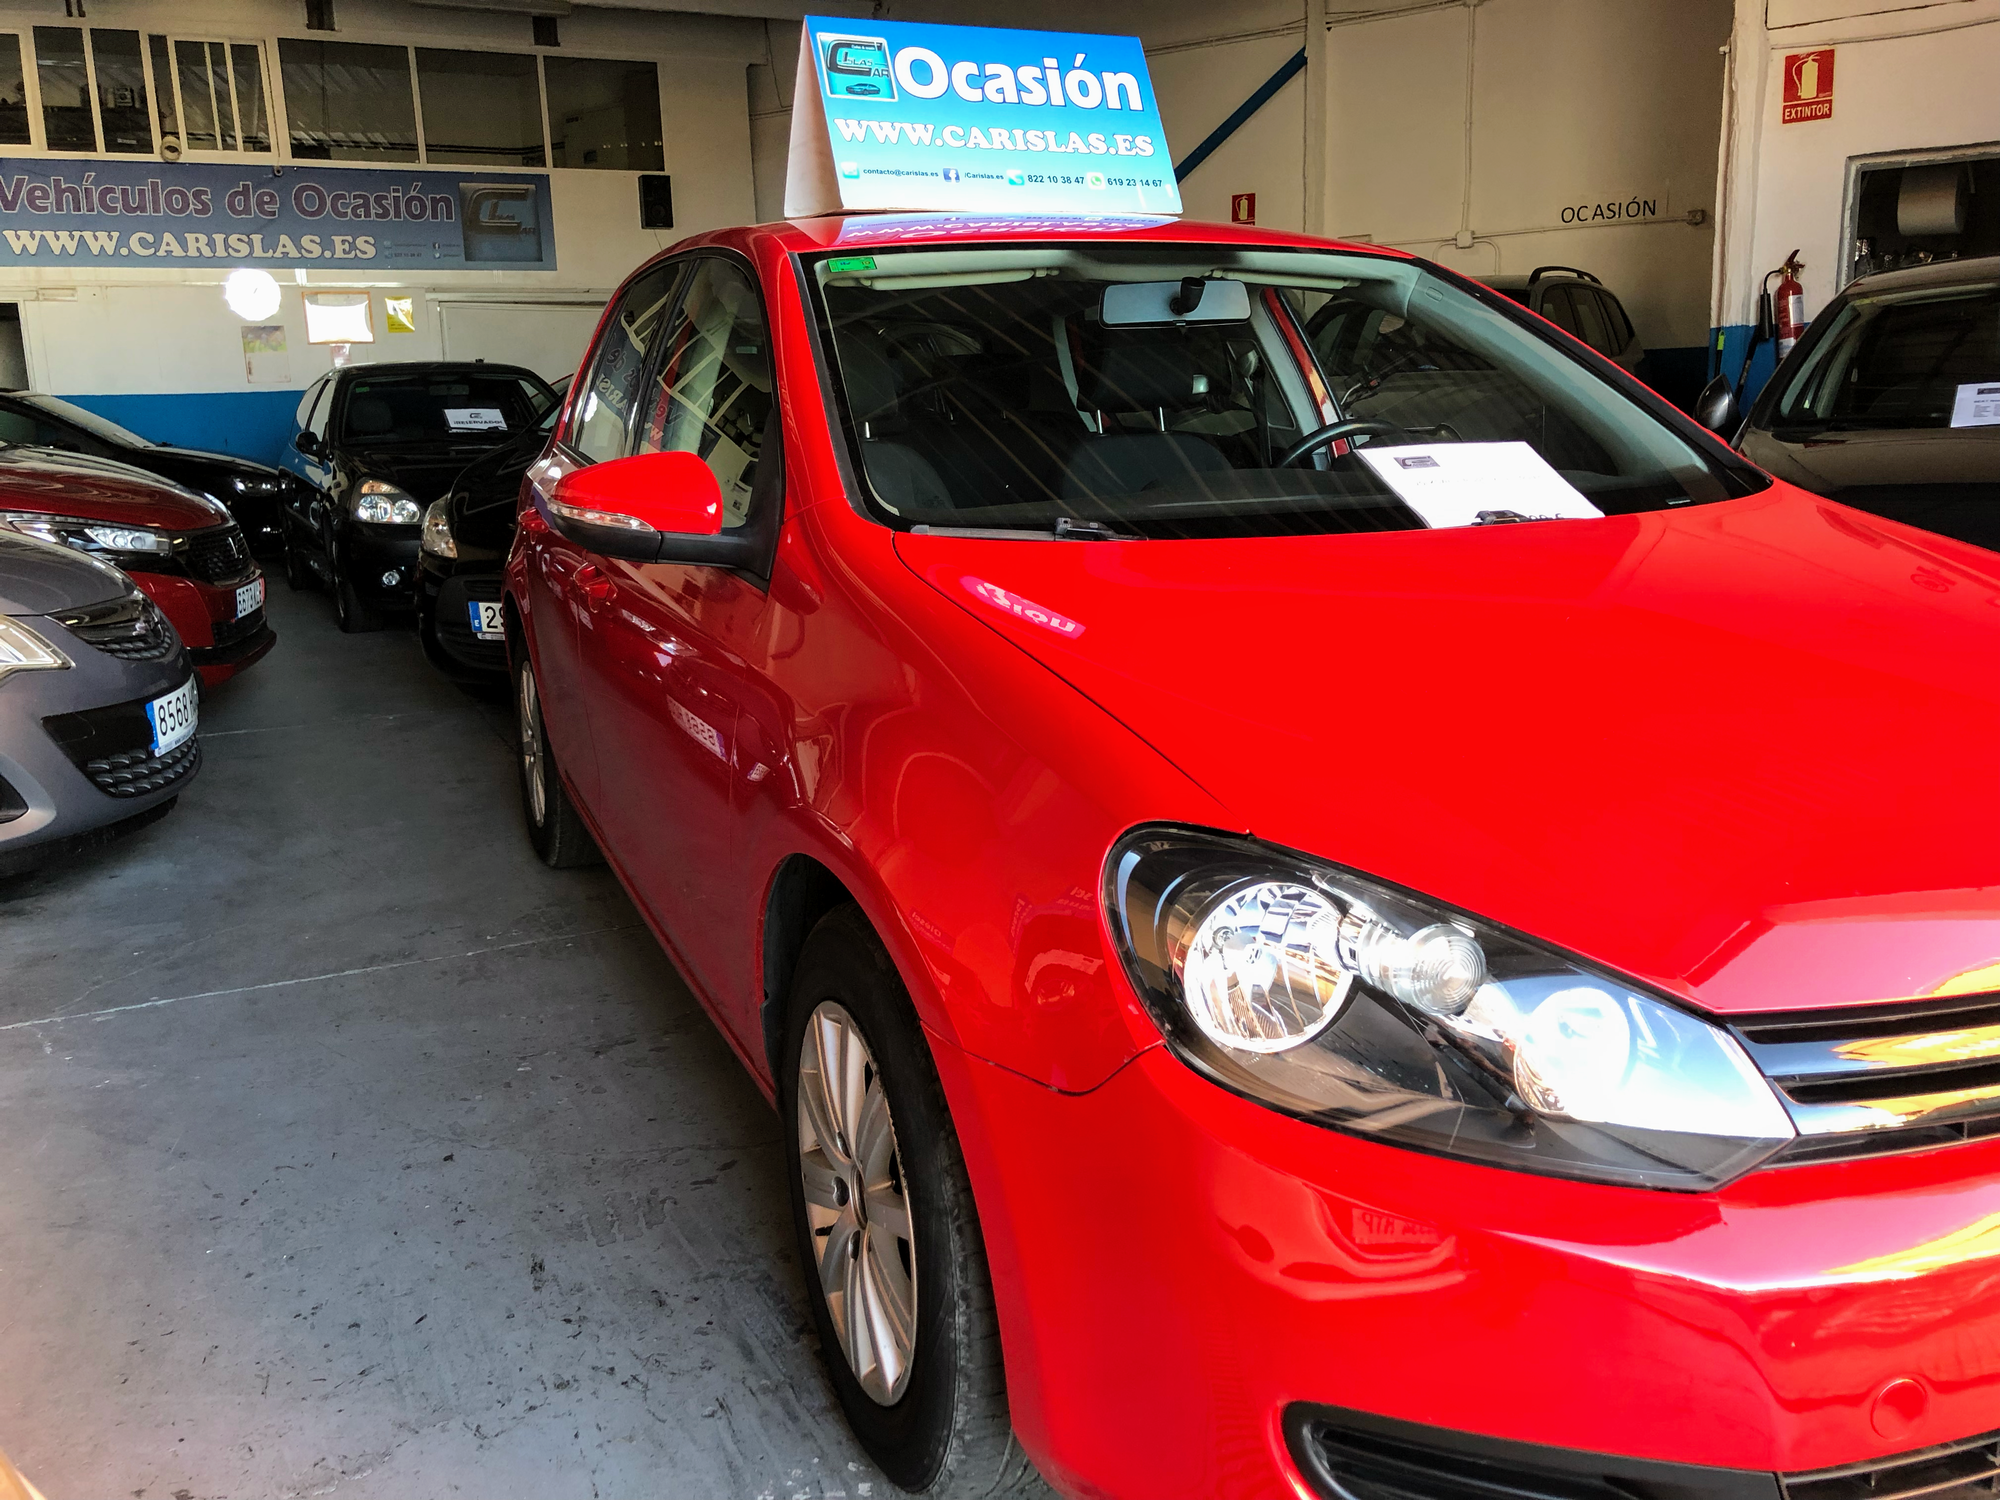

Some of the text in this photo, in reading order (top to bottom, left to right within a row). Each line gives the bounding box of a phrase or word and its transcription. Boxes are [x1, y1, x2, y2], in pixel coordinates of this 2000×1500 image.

[893, 46, 1144, 111] Ocasión
[1784, 103, 1830, 120] EXTINTOR
[833, 118, 1155, 158] WWW.CARISLAS.ES
[863, 168, 939, 177] contacto@carislas.es
[1027, 174, 1085, 185] 822 10 38 47
[1107, 177, 1163, 187] 619 23 14 67
[0, 172, 456, 222] Vehículos de Ocasión
[1561, 196, 1656, 224] OCASIÓN
[2, 229, 378, 260] WWW.CARISLAS.ES
[158, 692, 189, 737] 8568
